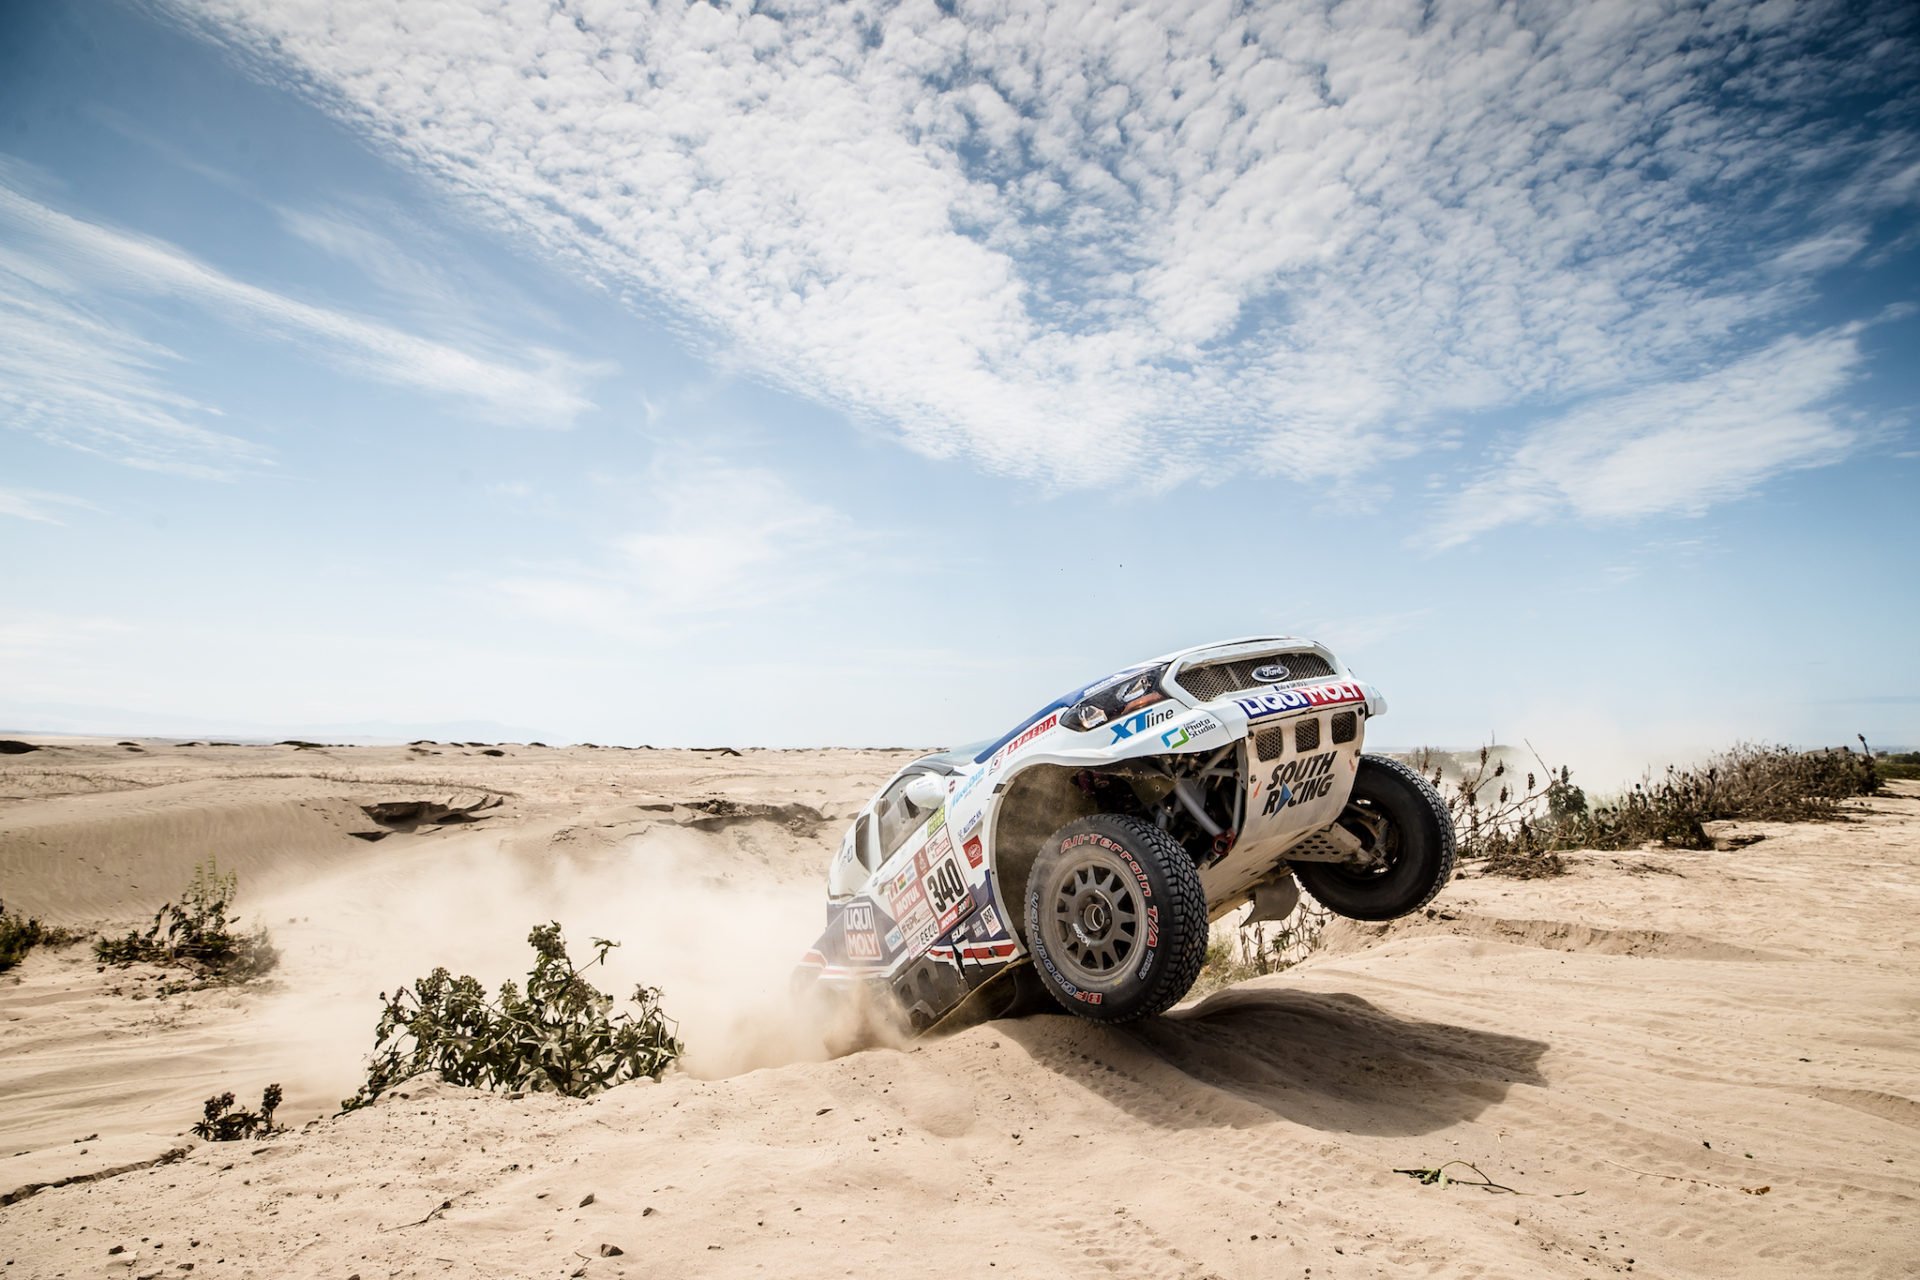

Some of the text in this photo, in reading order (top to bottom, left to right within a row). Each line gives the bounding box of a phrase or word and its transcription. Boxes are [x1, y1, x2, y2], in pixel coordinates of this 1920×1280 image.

[1261, 666, 1283, 677] Ford
[1240, 690, 1308, 715] LIQUI
[1299, 681, 1360, 702] MOLY
[1110, 708, 1174, 745] XTline
[1185, 719, 1211, 733] Photo
[1188, 723, 1217, 739] Studio
[1266, 749, 1338, 790] SOUTH
[926, 858, 965, 912] 340
[1060, 833, 1159, 947] All-Terrain T/A
[845, 907, 873, 931] LIQUI
[847, 932, 878, 956] MOLY
[1031, 891, 1103, 1005] BFGoodrich
